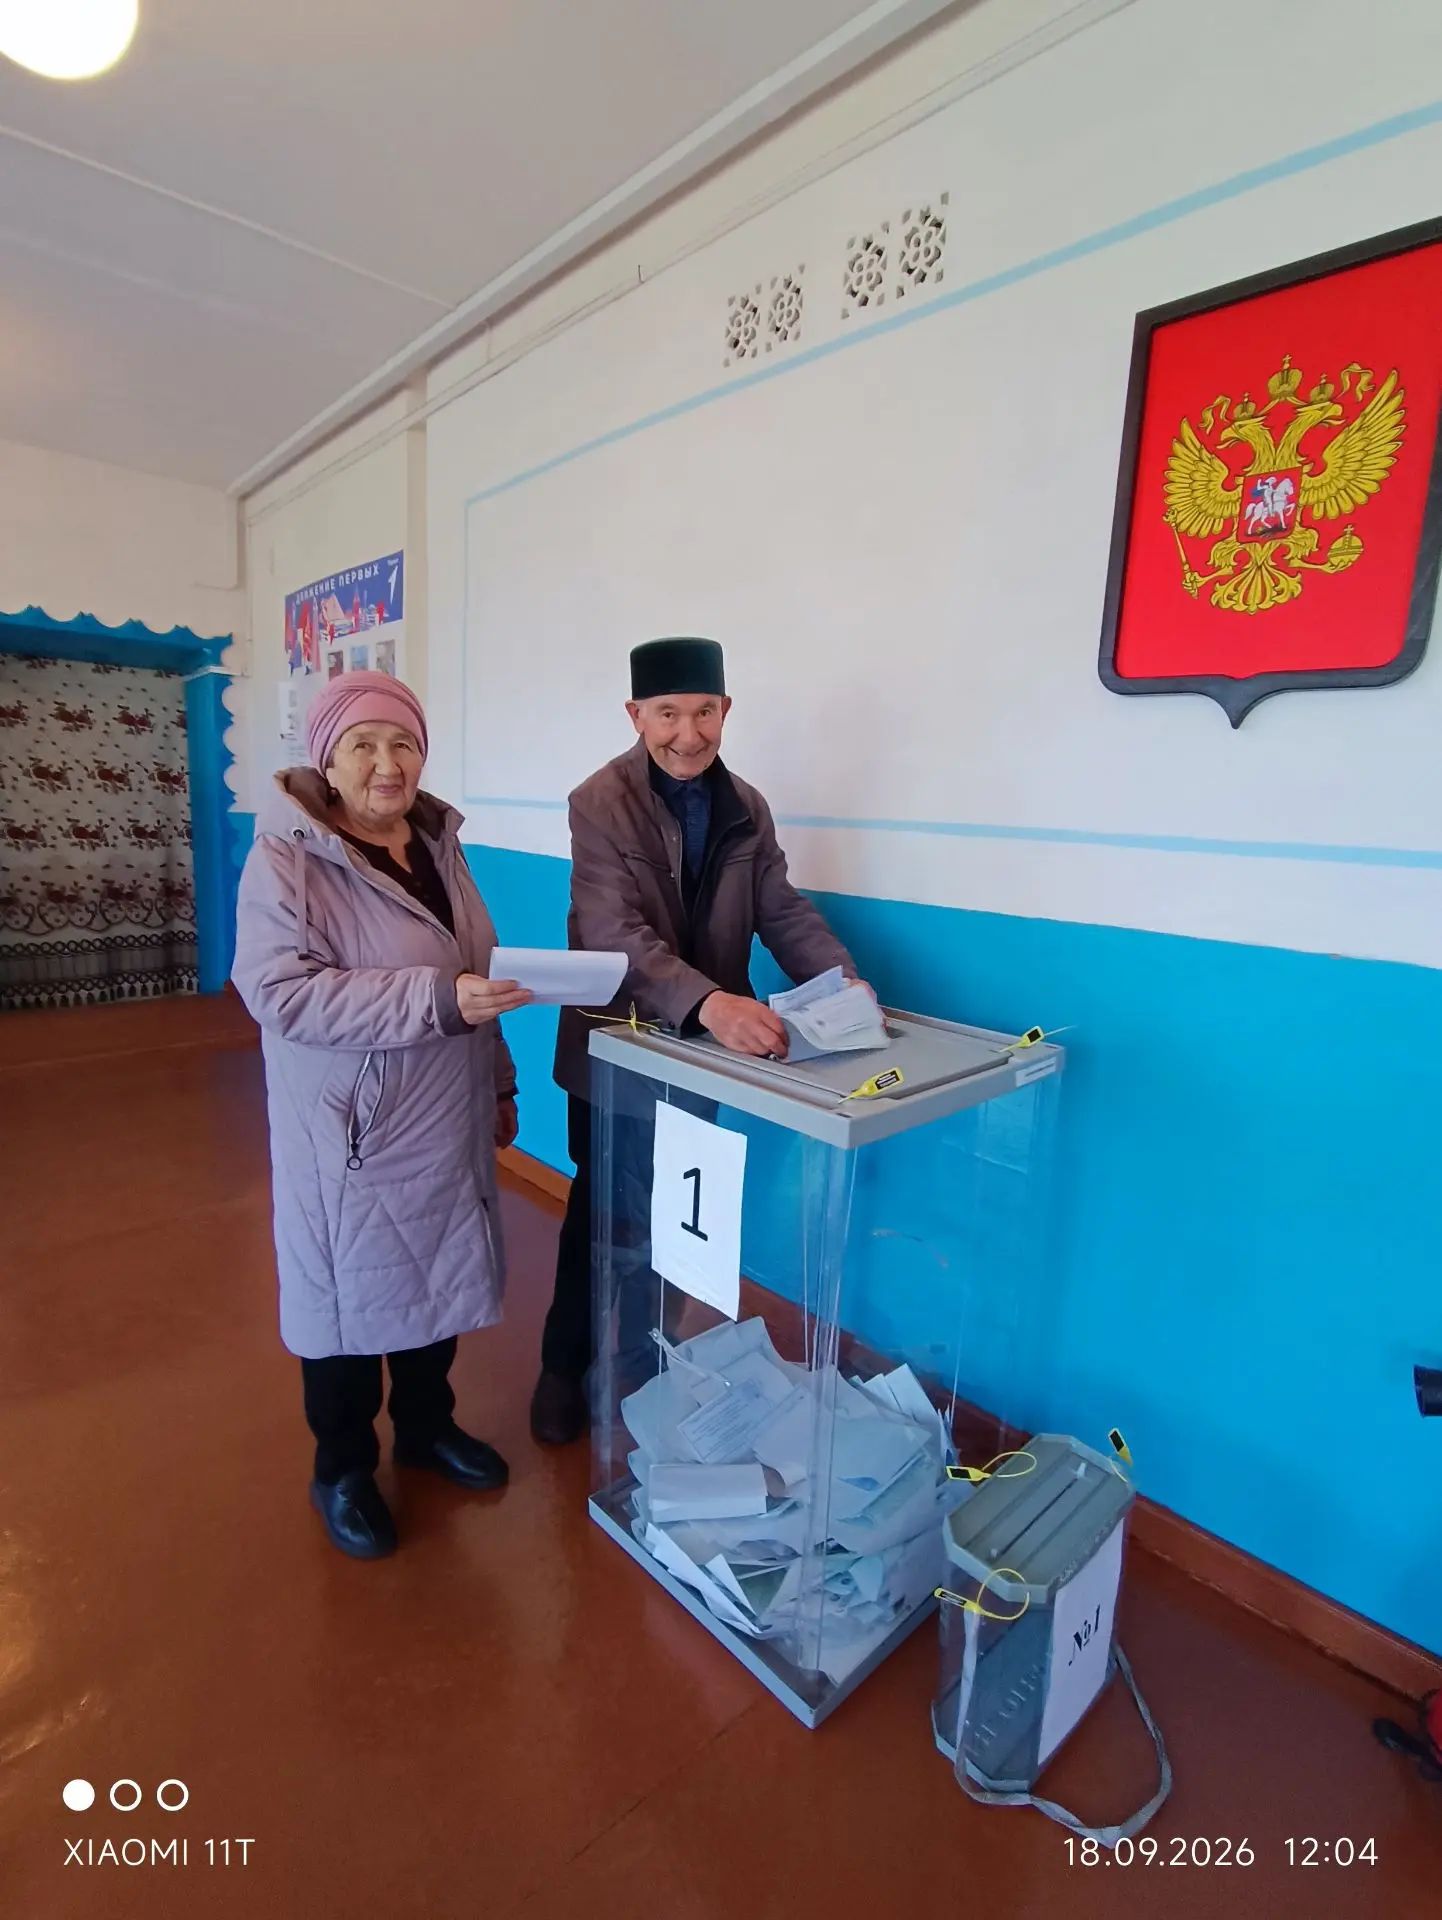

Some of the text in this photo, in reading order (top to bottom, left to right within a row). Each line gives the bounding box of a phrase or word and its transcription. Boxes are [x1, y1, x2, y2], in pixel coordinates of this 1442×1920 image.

[296, 563, 379, 605] ДВИЖЕНИЕ ПЕРВЫХ
[681, 1167, 708, 1242] 1
